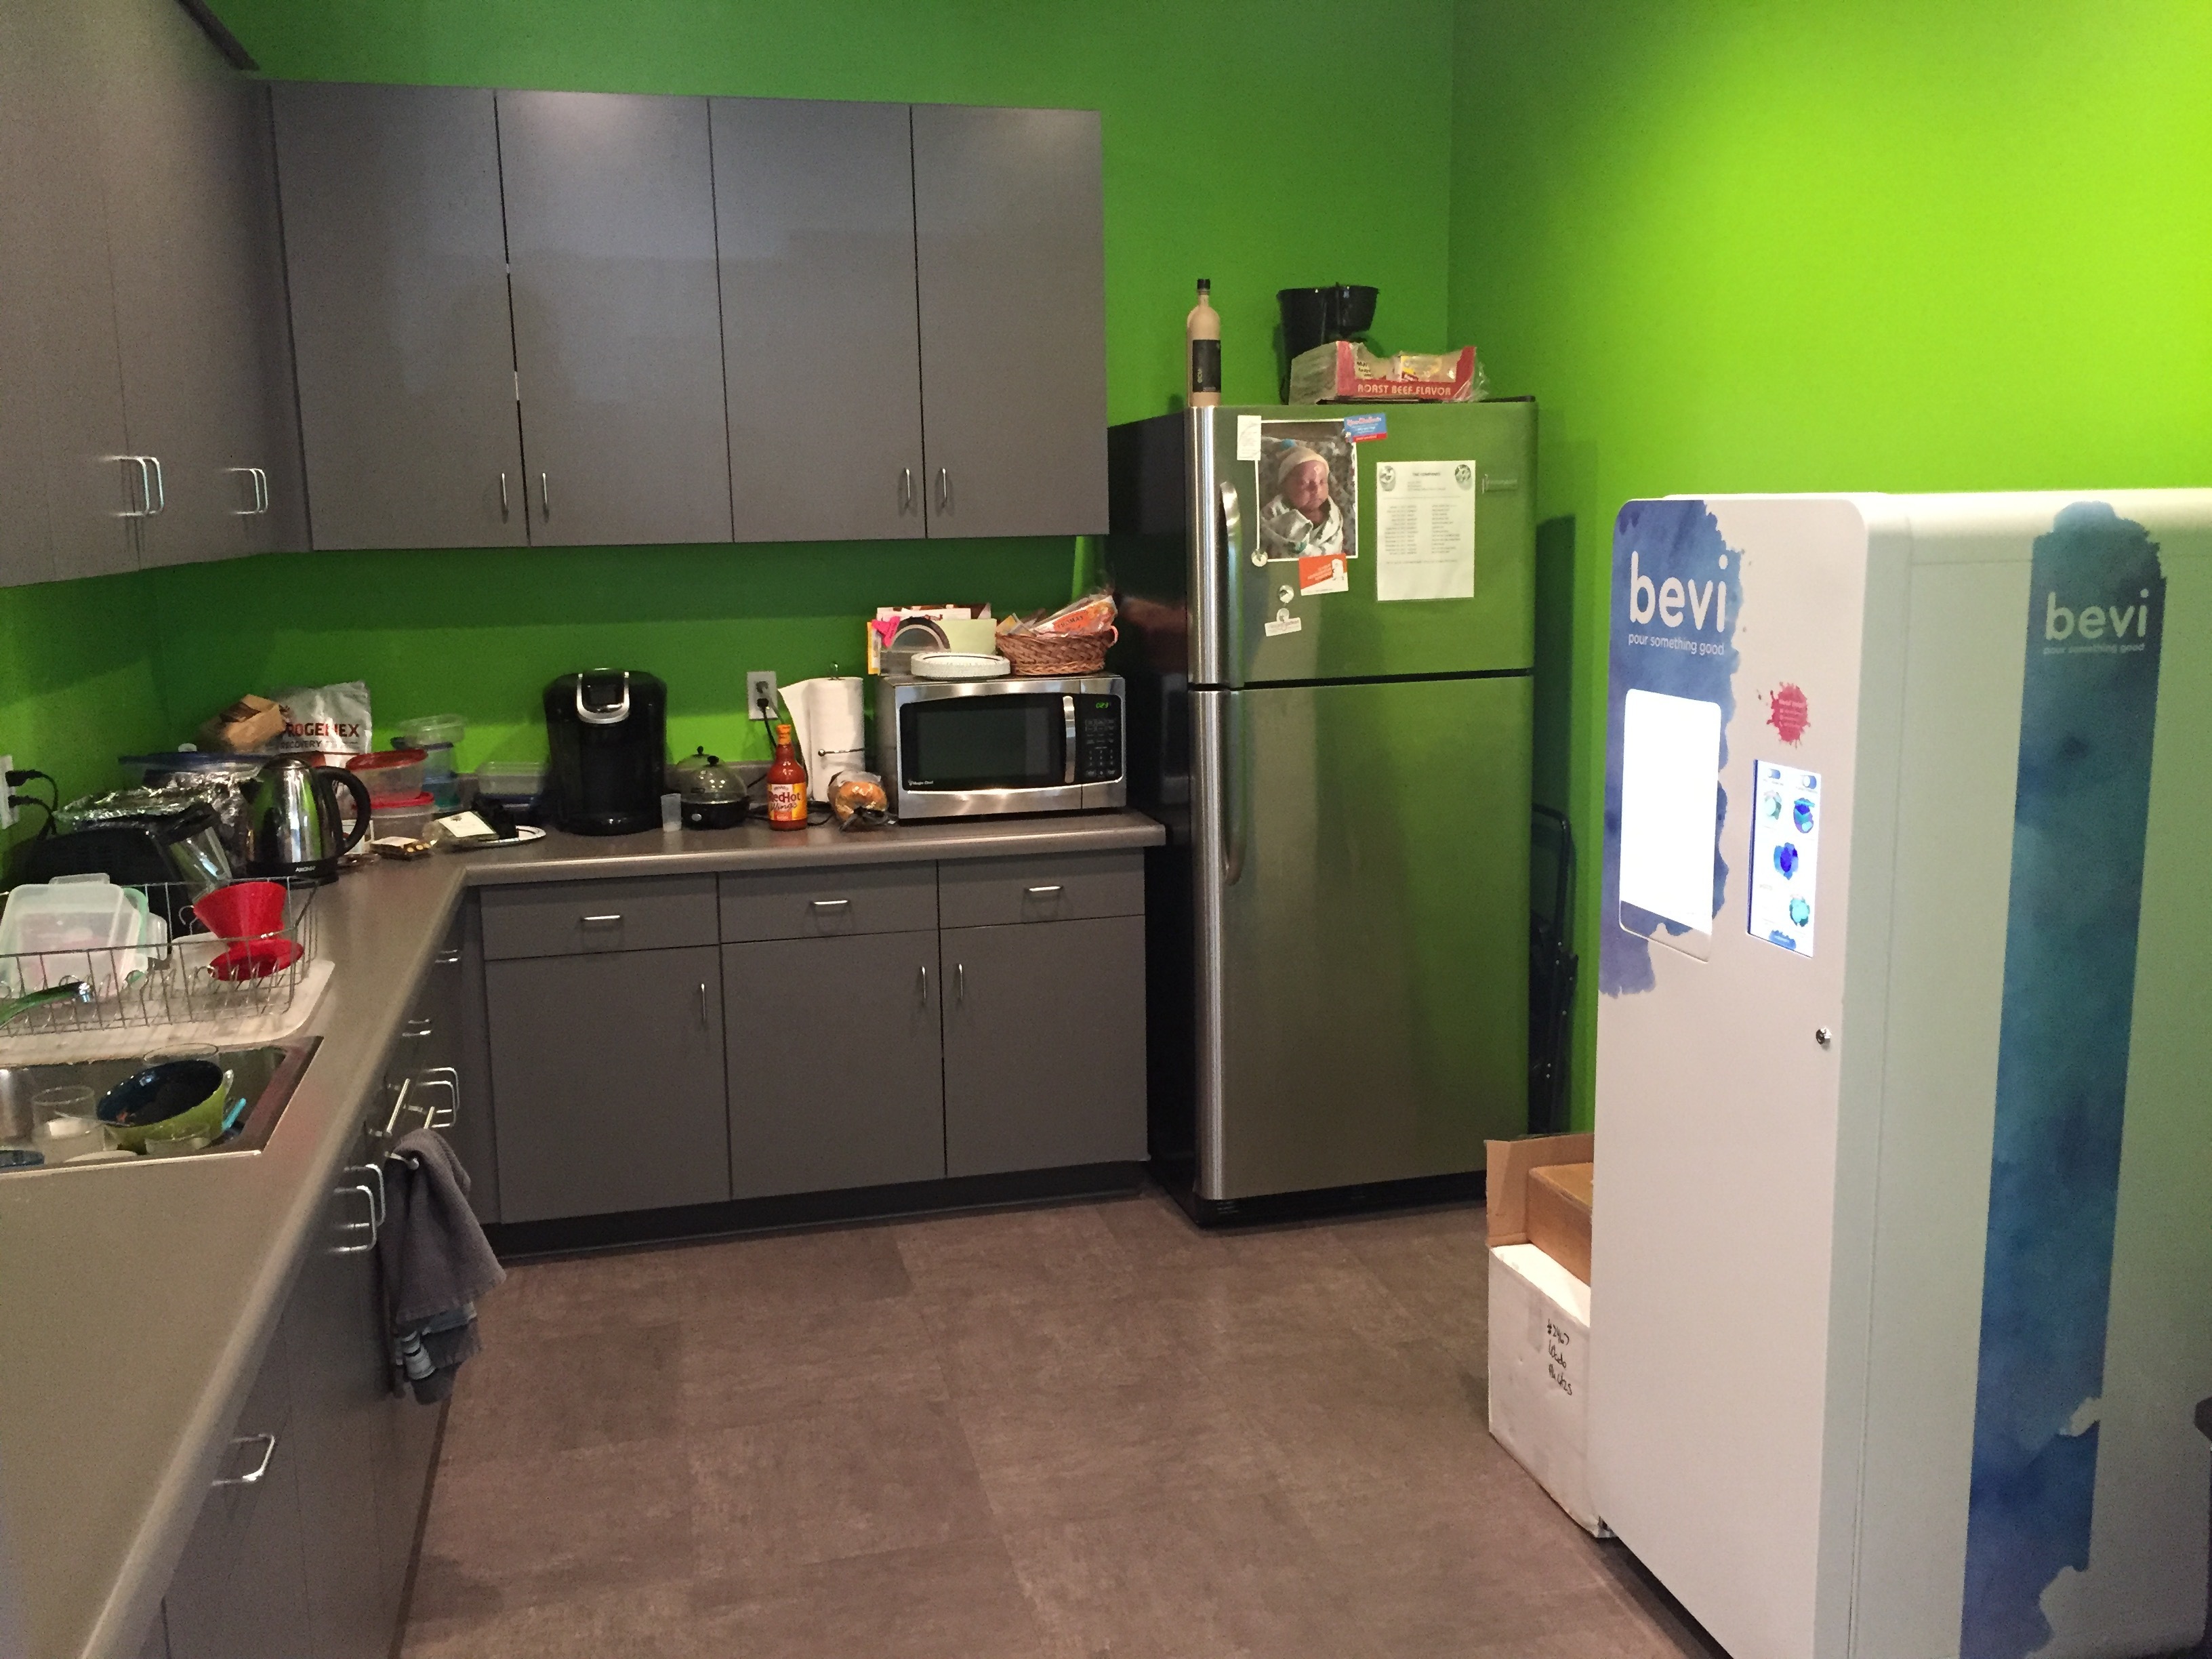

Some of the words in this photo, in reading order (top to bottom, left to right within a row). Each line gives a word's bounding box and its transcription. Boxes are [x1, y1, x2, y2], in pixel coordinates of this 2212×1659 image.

[1357, 384, 1389, 394] ROAST
[1391, 385, 1413, 394] BEEF
[1416, 386, 1451, 396] FLAVOR
[1629, 551, 1728, 632] bevi
[2045, 588, 2149, 640] bevi
[1628, 634, 1648, 645] pour
[1650, 636, 1698, 655] something
[1700, 642, 1725, 655] good
